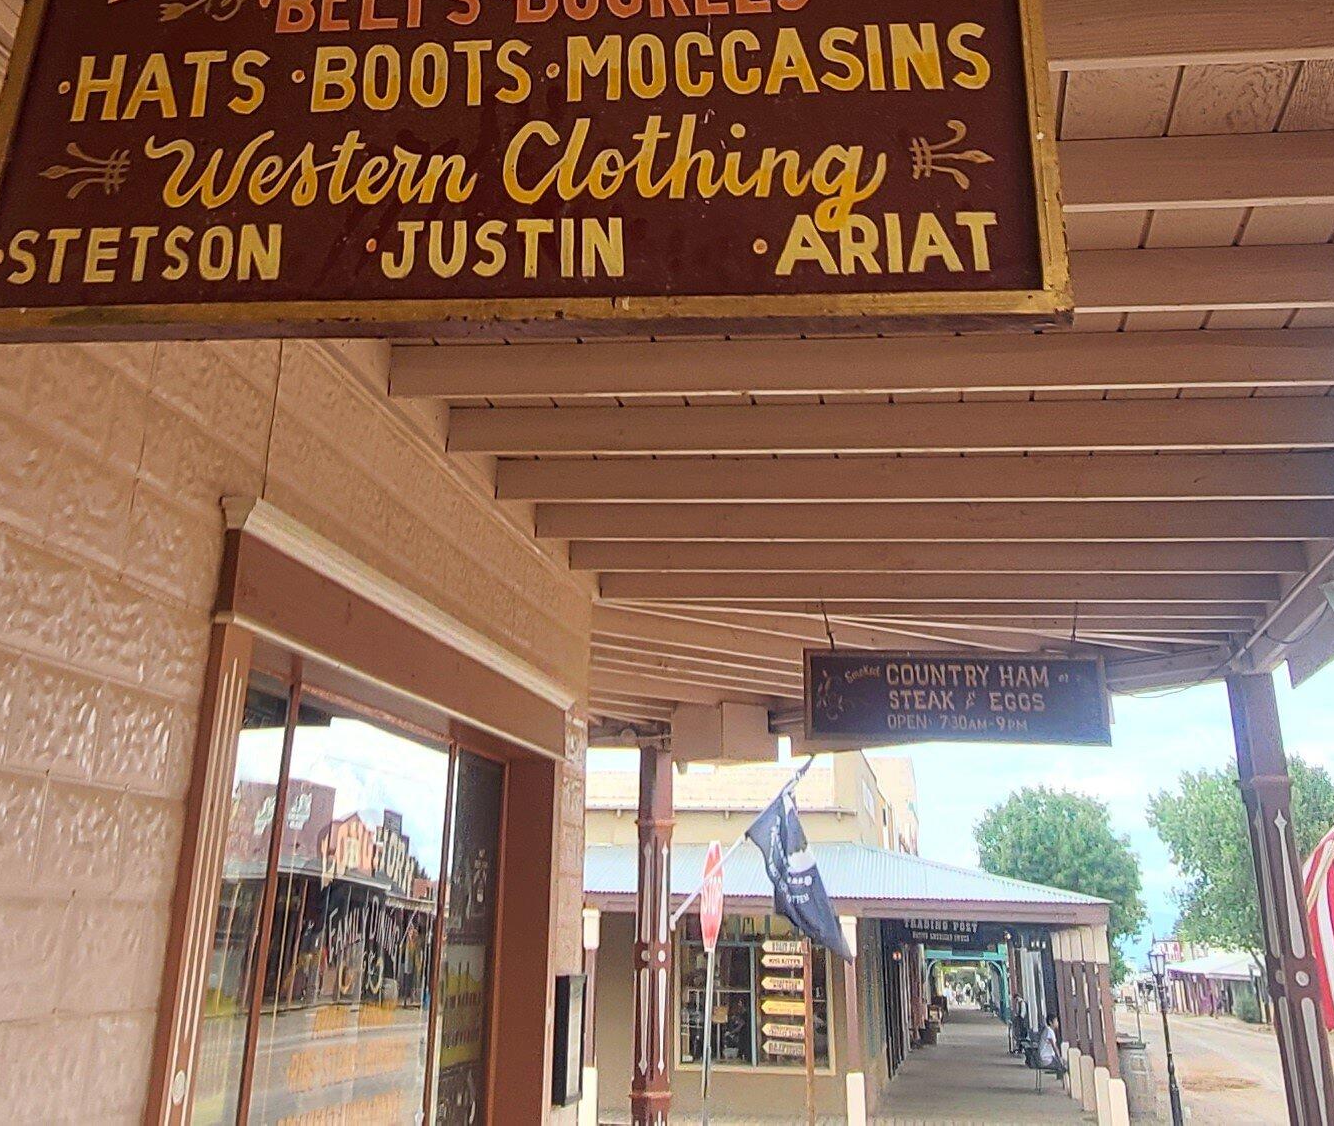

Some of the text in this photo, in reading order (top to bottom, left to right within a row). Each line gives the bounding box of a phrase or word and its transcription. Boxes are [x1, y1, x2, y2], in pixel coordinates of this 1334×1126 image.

[144, 113, 887, 233] Western Clothing
[885, 663, 990, 688] COUNTRY
[999, 664, 1050, 689] HAM
[889, 690, 1046, 713] STEAK & EGGS
[328, 904, 369, 964] FAMILY
